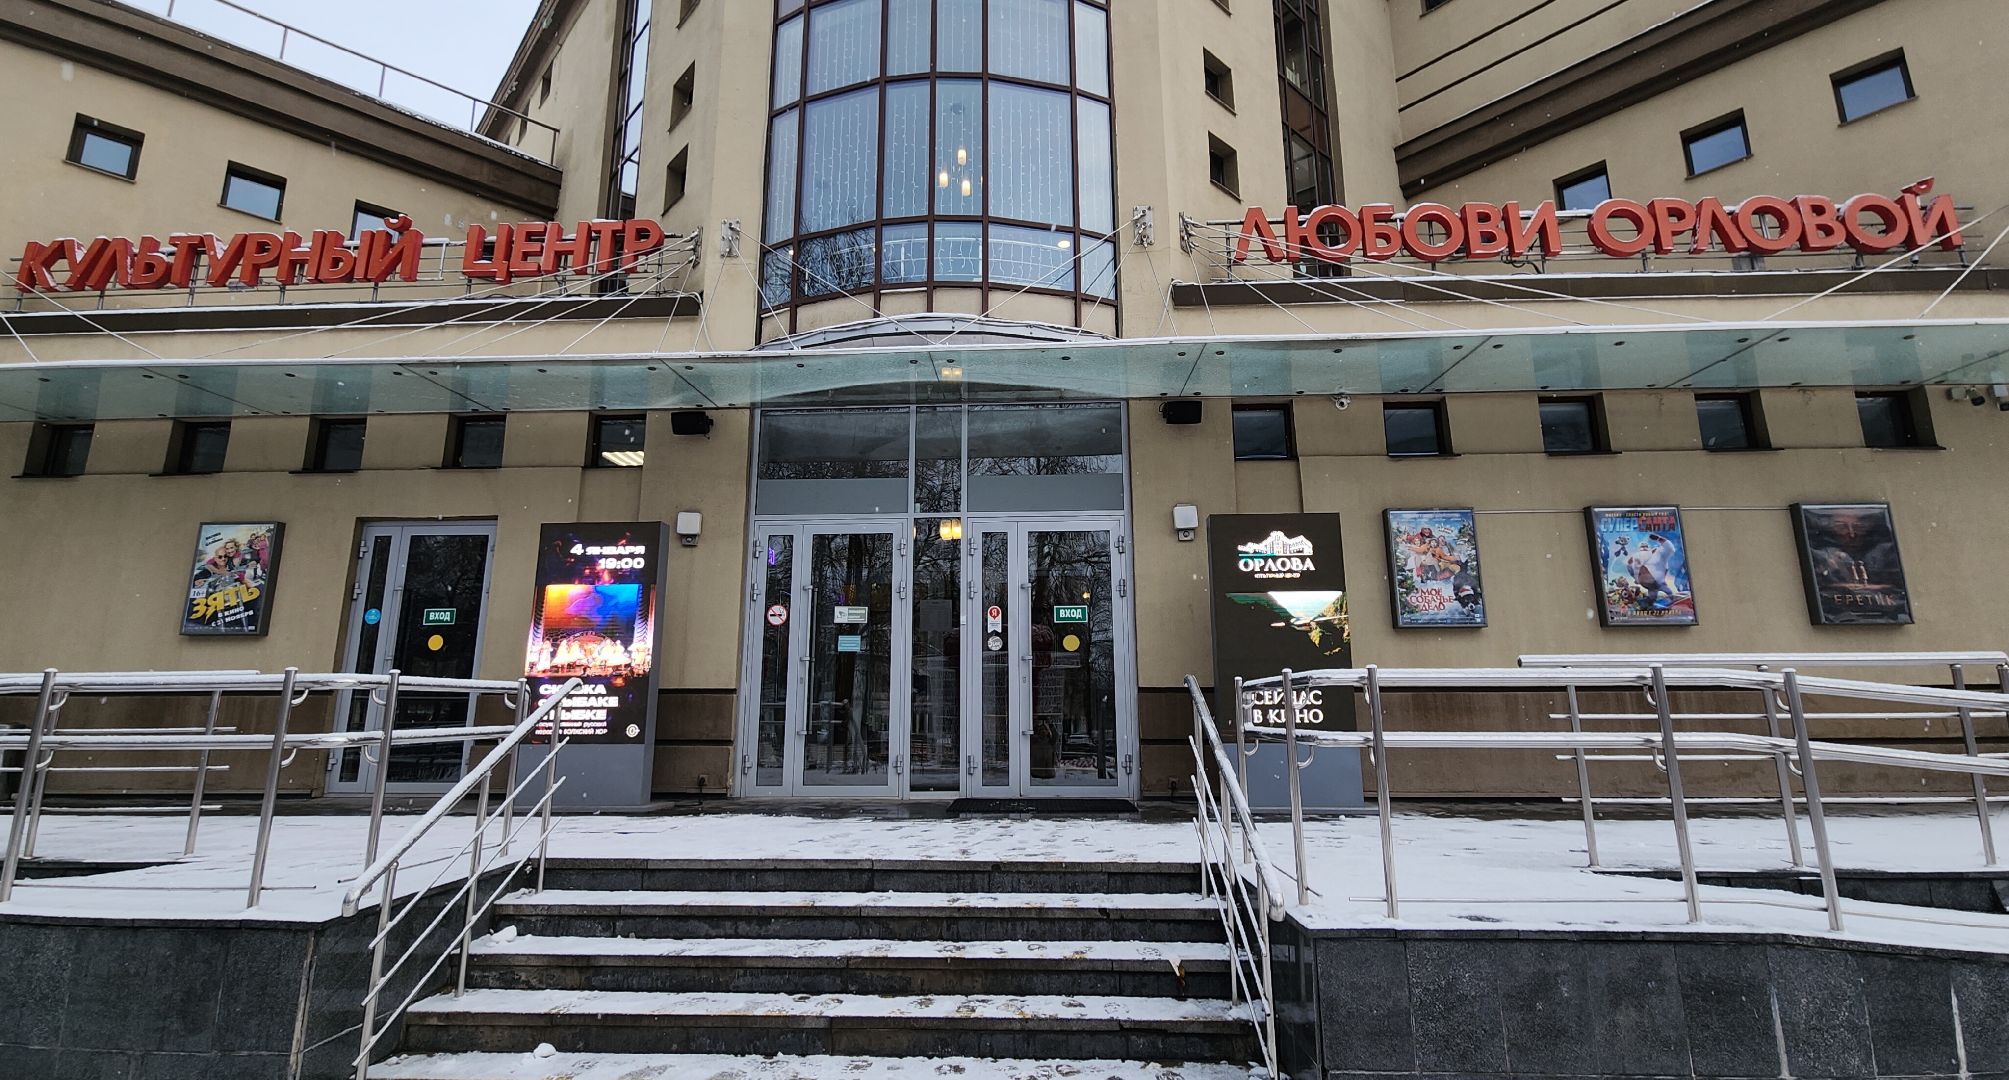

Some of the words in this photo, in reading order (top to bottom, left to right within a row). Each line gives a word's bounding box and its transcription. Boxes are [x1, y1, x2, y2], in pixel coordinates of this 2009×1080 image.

[1233, 200, 1563, 263] ЛЮБОВИ
[1586, 176, 1964, 257] ОРЛОВОЙ
[18, 213, 425, 292] КУЛЬТУРНЫЙ
[462, 218, 665, 284] ЦЕНТР
[569, 543, 585, 556] 4
[585, 545, 646, 556] ЯНВАРЯ
[598, 557, 645, 570] 19:00
[1238, 557, 1316, 572] ОРЛОВА
[189, 584, 260, 624] ЗЯТЬ
[1409, 594, 1454, 605] СОБАЧЬЕ
[224, 606, 244, 617] КИНО
[1059, 608, 1083, 619] ВХОД
[1420, 602, 1446, 612] ДЕЛО
[429, 611, 451, 621] ВХОД
[1252, 708, 1263, 723] В
